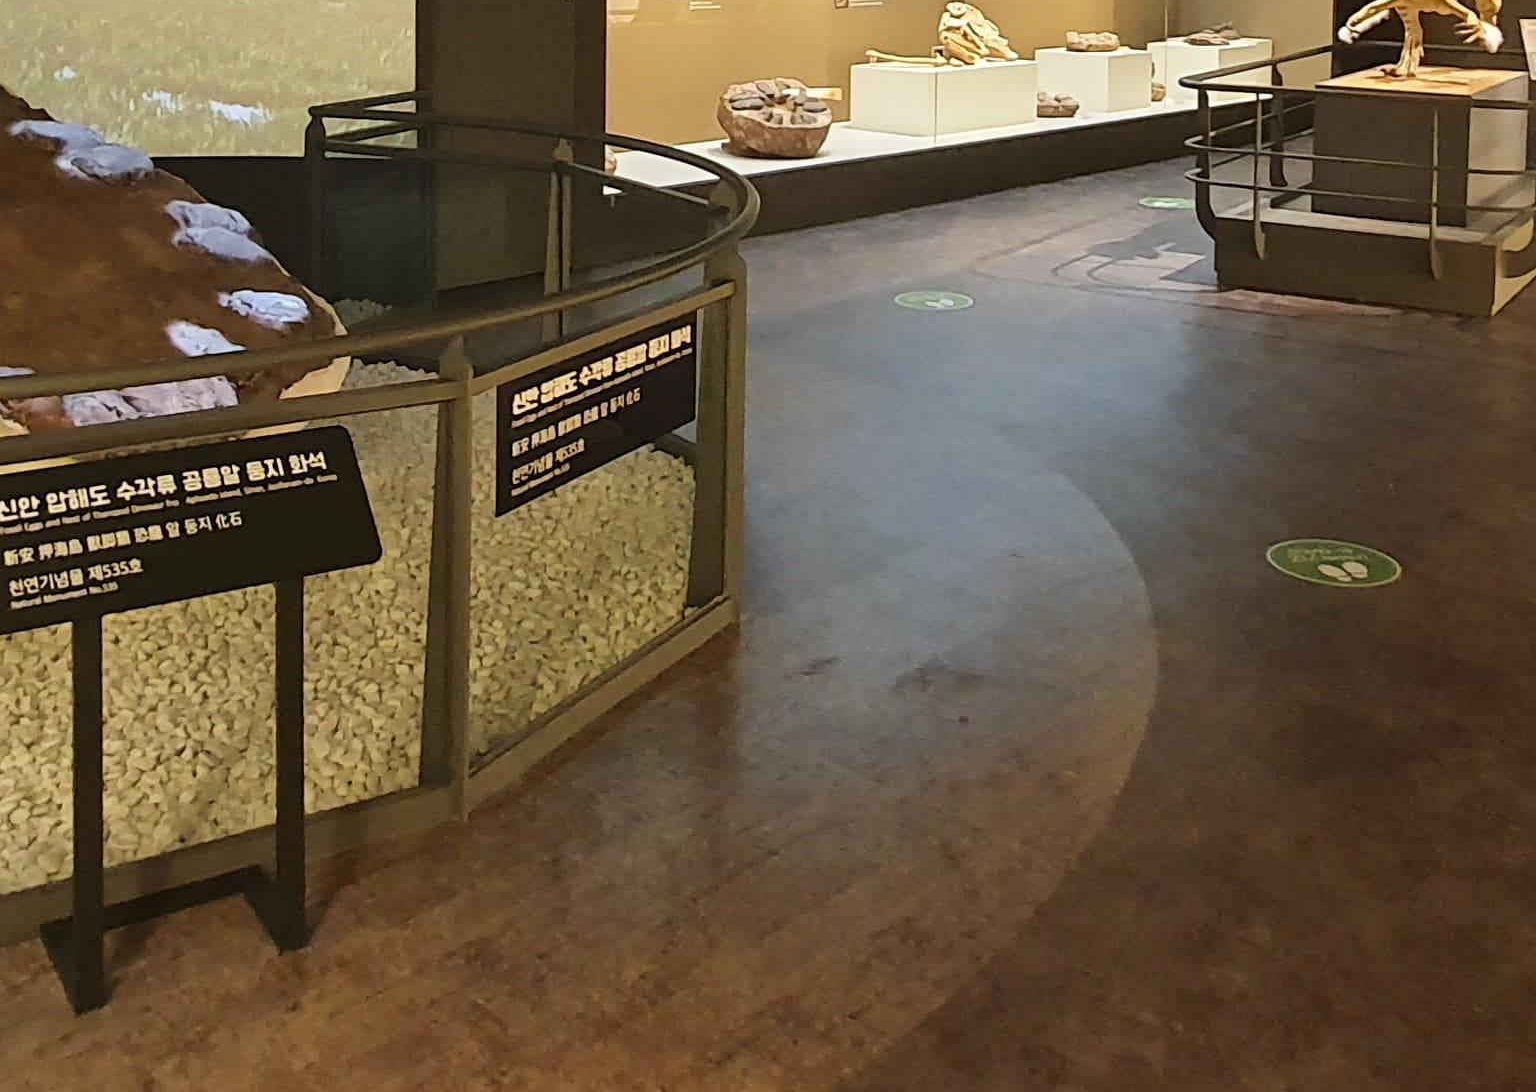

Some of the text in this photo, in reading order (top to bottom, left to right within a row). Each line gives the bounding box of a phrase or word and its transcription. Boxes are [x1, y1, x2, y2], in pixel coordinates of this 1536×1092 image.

[45, 484, 111, 514] 압해도
[116, 474, 177, 501] 수각류
[181, 464, 241, 492] 공룡알
[245, 457, 285, 482] 둥지
[288, 451, 327, 475] 화석
[184, 515, 213, 536] 둥지
[215, 511, 243, 530] 化石
[8, 558, 144, 597] 천연기념물 제535호
